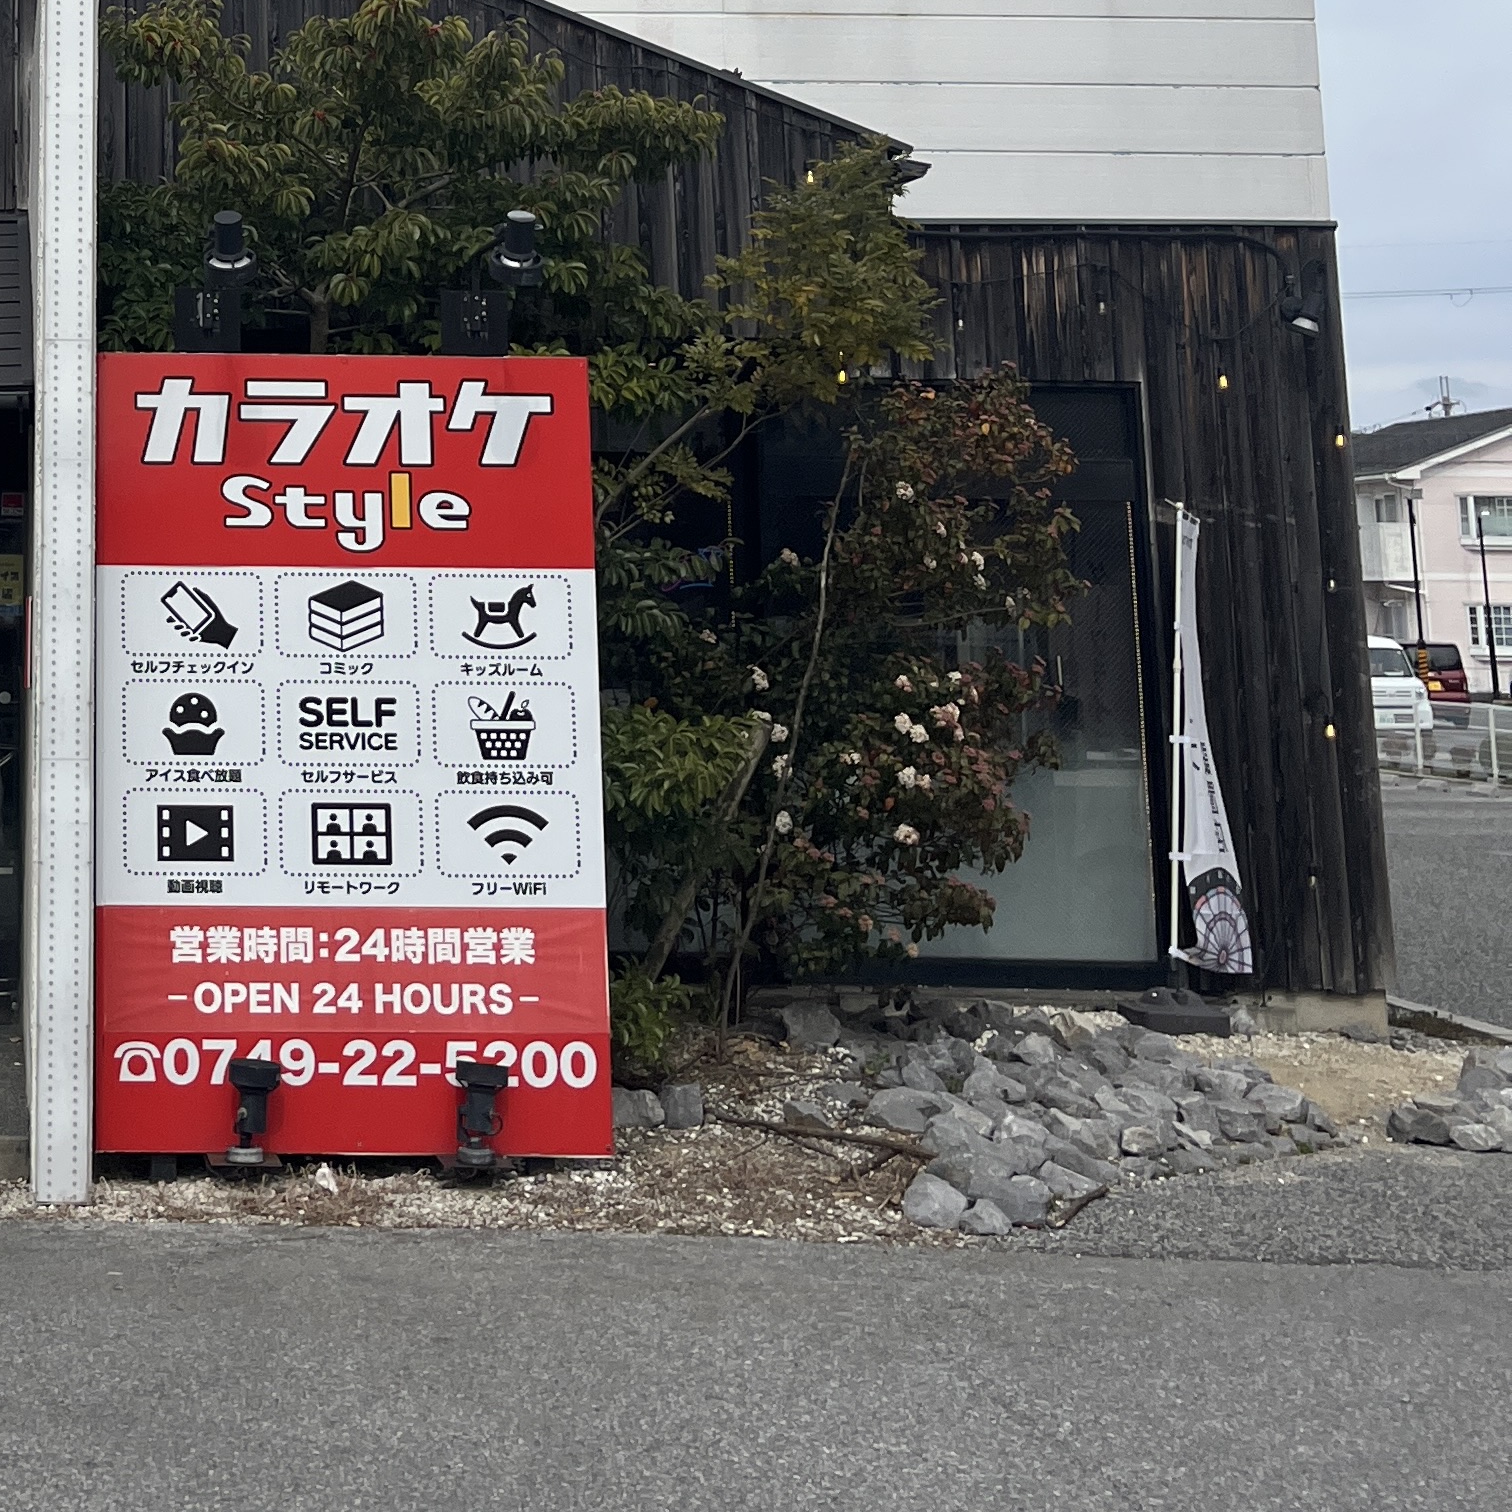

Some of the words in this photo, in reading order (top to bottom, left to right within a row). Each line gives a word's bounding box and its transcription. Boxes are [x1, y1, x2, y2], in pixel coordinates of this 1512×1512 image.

[135, 377, 553, 466] カラオケ
[221, 472, 472, 552] Style
[132, 661, 254, 675] セルフチェックイン
[321, 662, 374, 676] コミック
[461, 663, 543, 677] キッズルーム
[299, 697, 397, 728] SELF
[300, 732, 398, 751] SERVICE
[146, 769, 242, 783] アイス食べ放題
[301, 770, 398, 784] セルフサービス
[457, 771, 554, 786] 飲食持ち込み可
[167, 880, 223, 894] 動画視聴
[305, 881, 400, 895] リモートワーク
[472, 882, 547, 896] フリーWiFi
[313, 983, 363, 1014] 24
